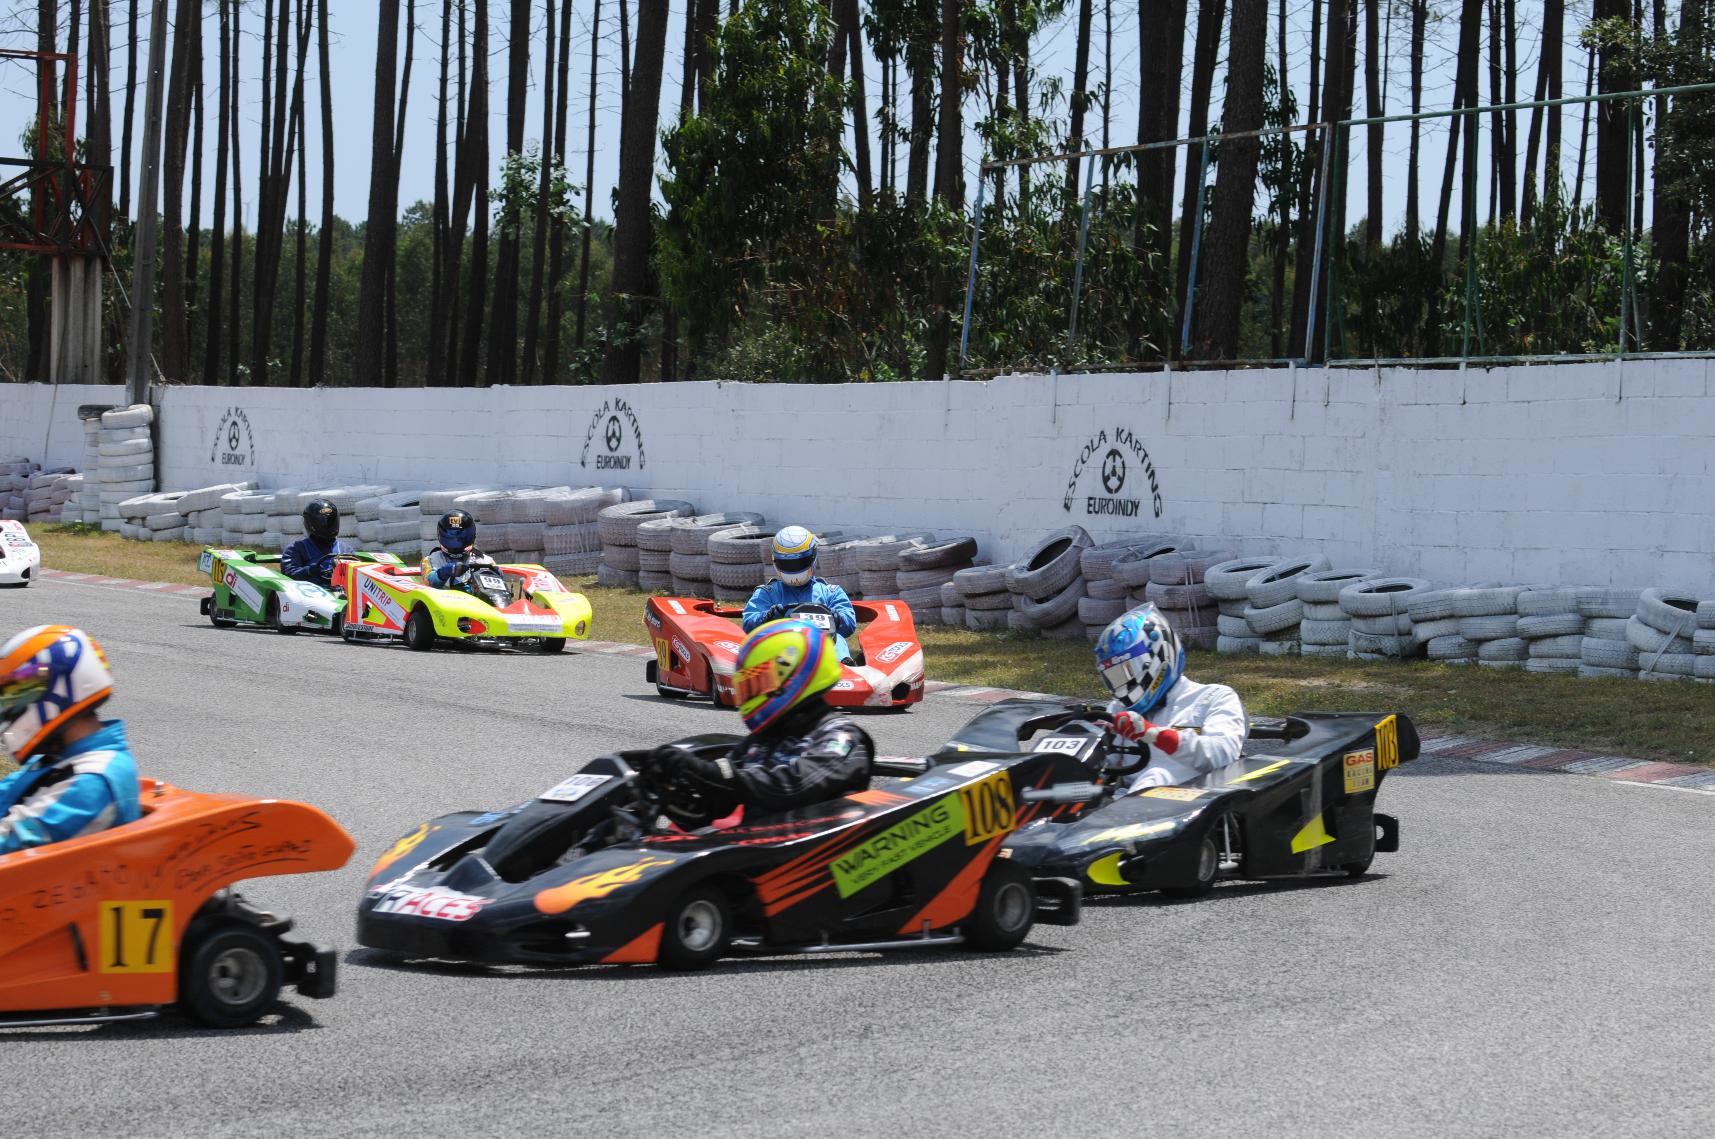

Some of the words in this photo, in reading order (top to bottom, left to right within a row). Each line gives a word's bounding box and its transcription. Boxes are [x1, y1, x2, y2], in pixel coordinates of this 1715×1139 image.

[581, 400, 610, 469] ESCOLA
[615, 397, 645, 470] KARTING
[597, 454, 631, 470] EUROINDY
[1064, 429, 1107, 512] ESCOLA
[1116, 426, 1162, 518] KARTING
[1087, 496, 1140, 517] EUROINDY
[363, 579, 392, 606] UNITRIP
[1043, 740, 1081, 750] 103
[1346, 752, 1373, 766] GAS
[964, 777, 1013, 839] 108
[835, 804, 949, 875] WARNING
[109, 906, 166, 968] 17
